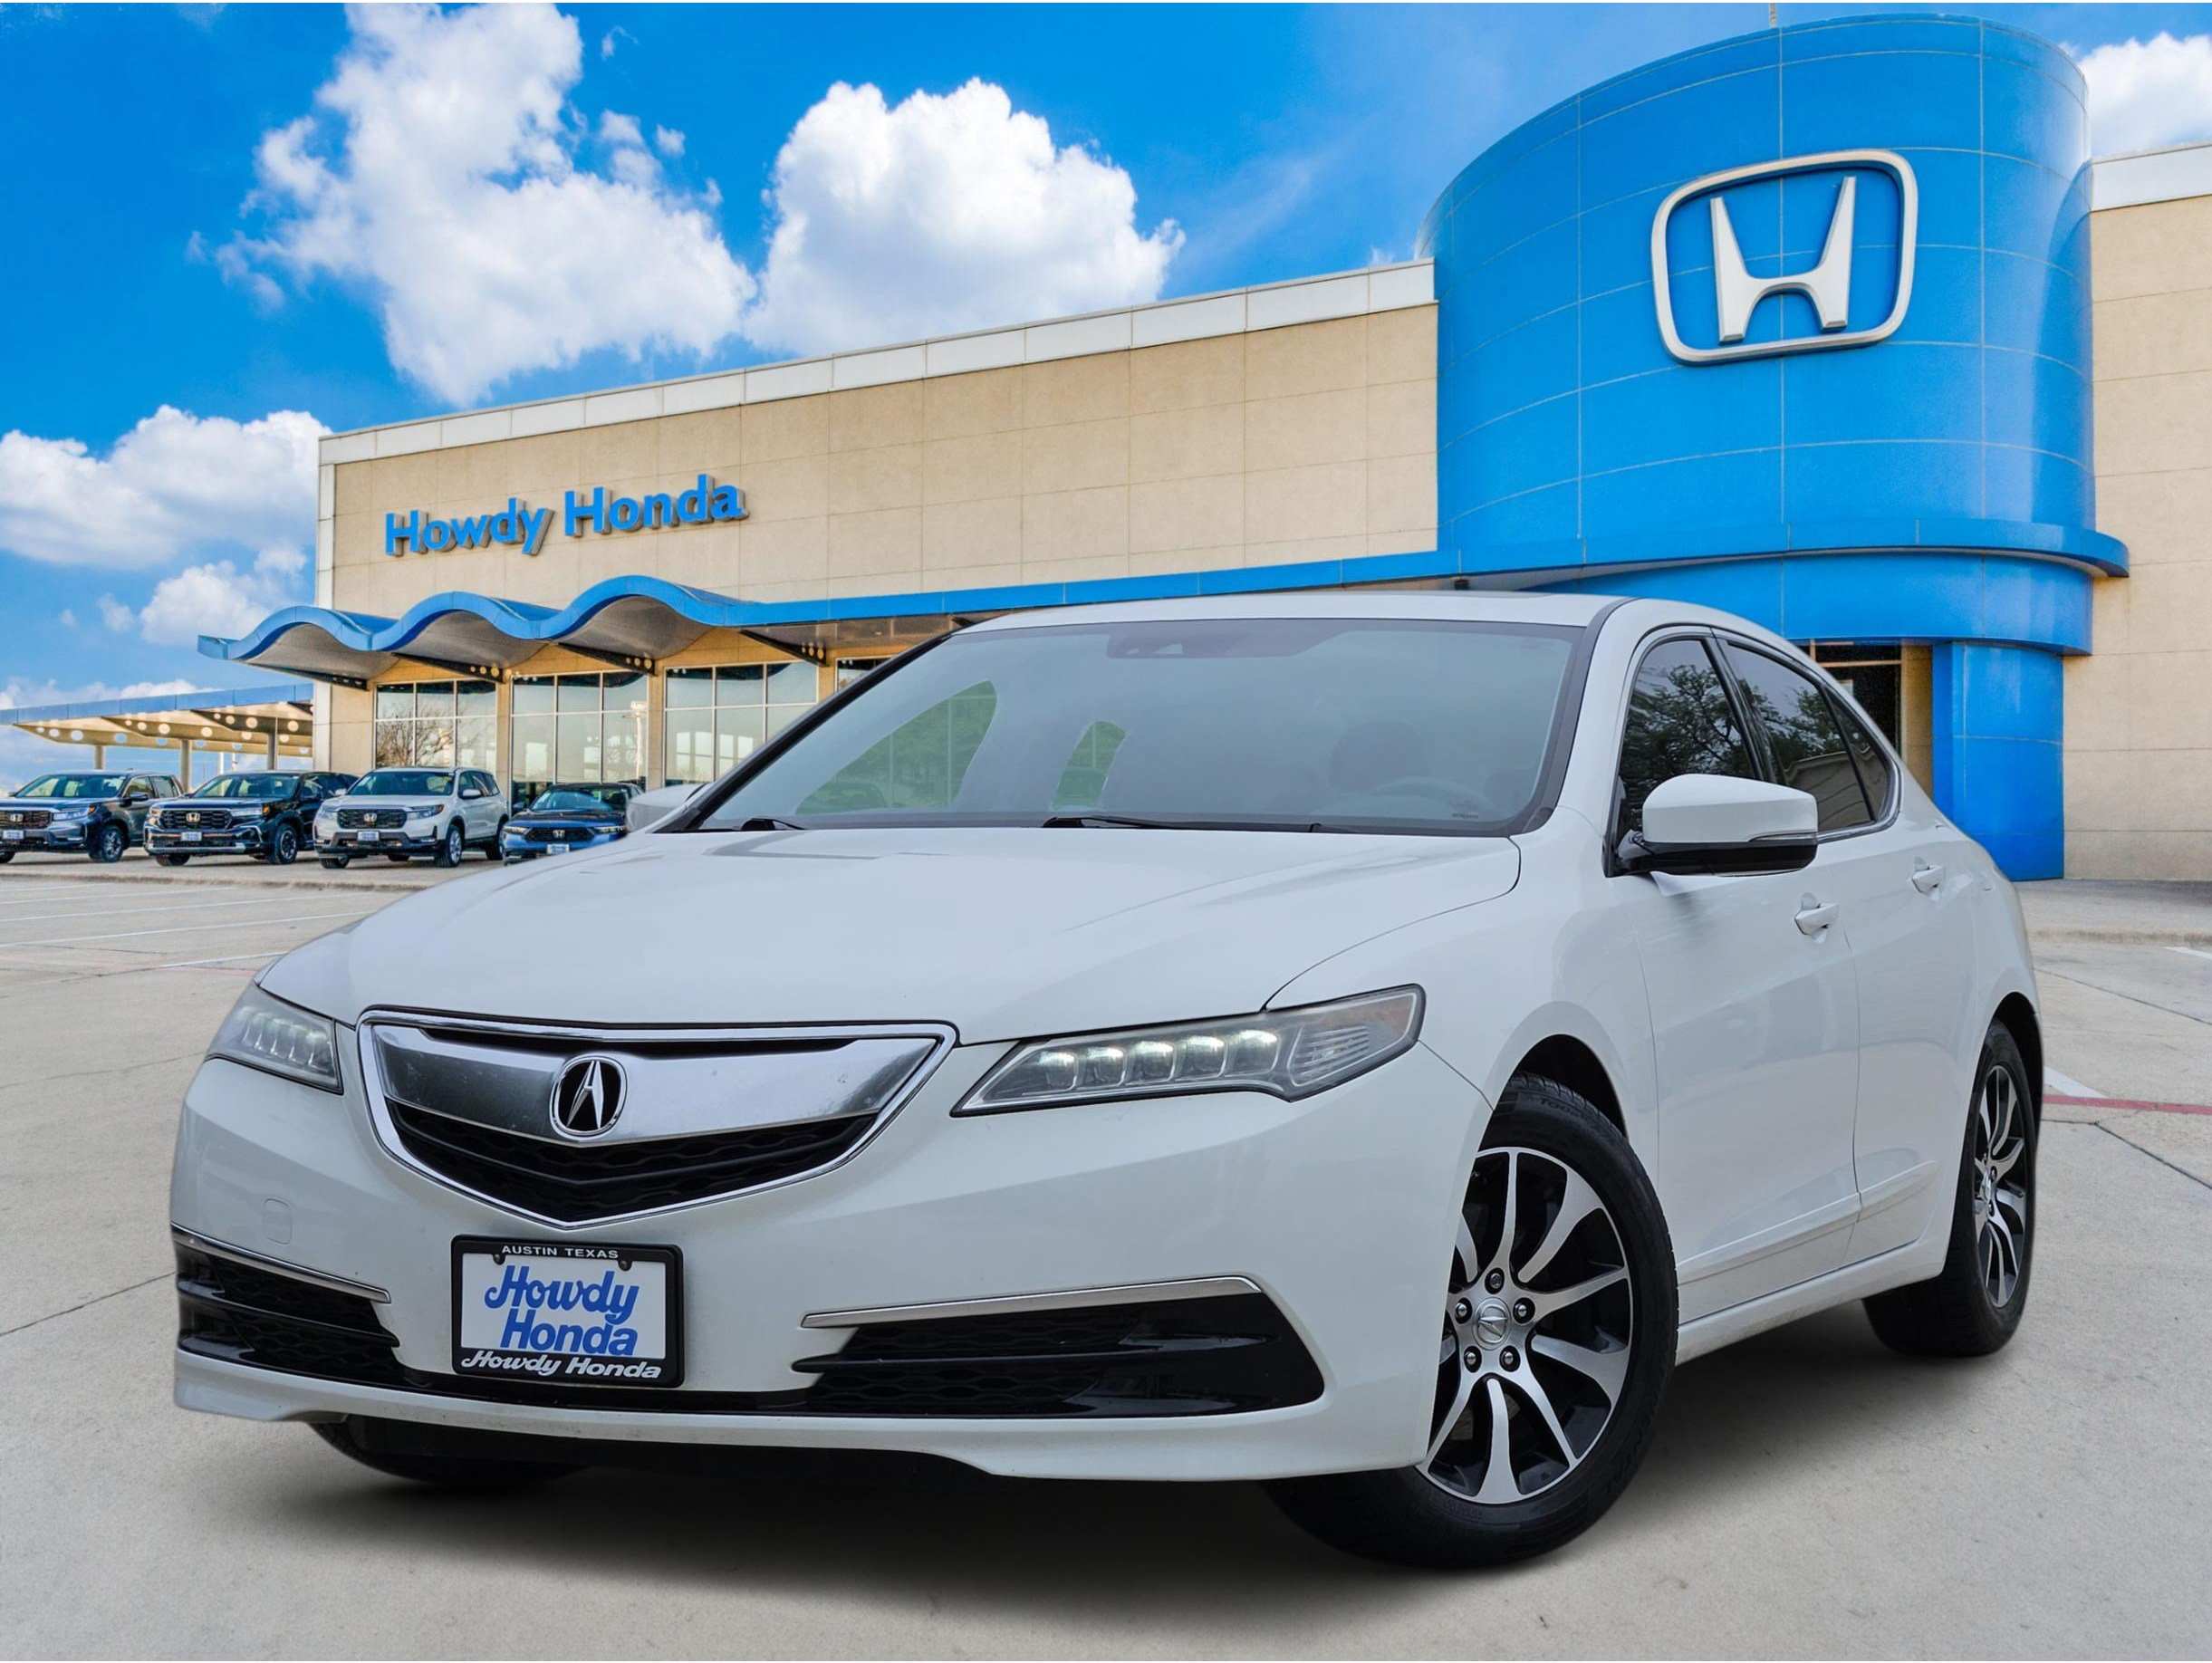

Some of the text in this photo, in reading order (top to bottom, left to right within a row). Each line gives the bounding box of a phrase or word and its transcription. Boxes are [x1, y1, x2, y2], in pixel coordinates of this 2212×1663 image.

[385, 474, 748, 556] Howdy Honda
[501, 1245, 619, 1259] AUSTIN TEXAS
[484, 1264, 640, 1325] Howdy
[500, 1308, 639, 1356] Honda
[461, 1350, 662, 1379] Howdy Honda
